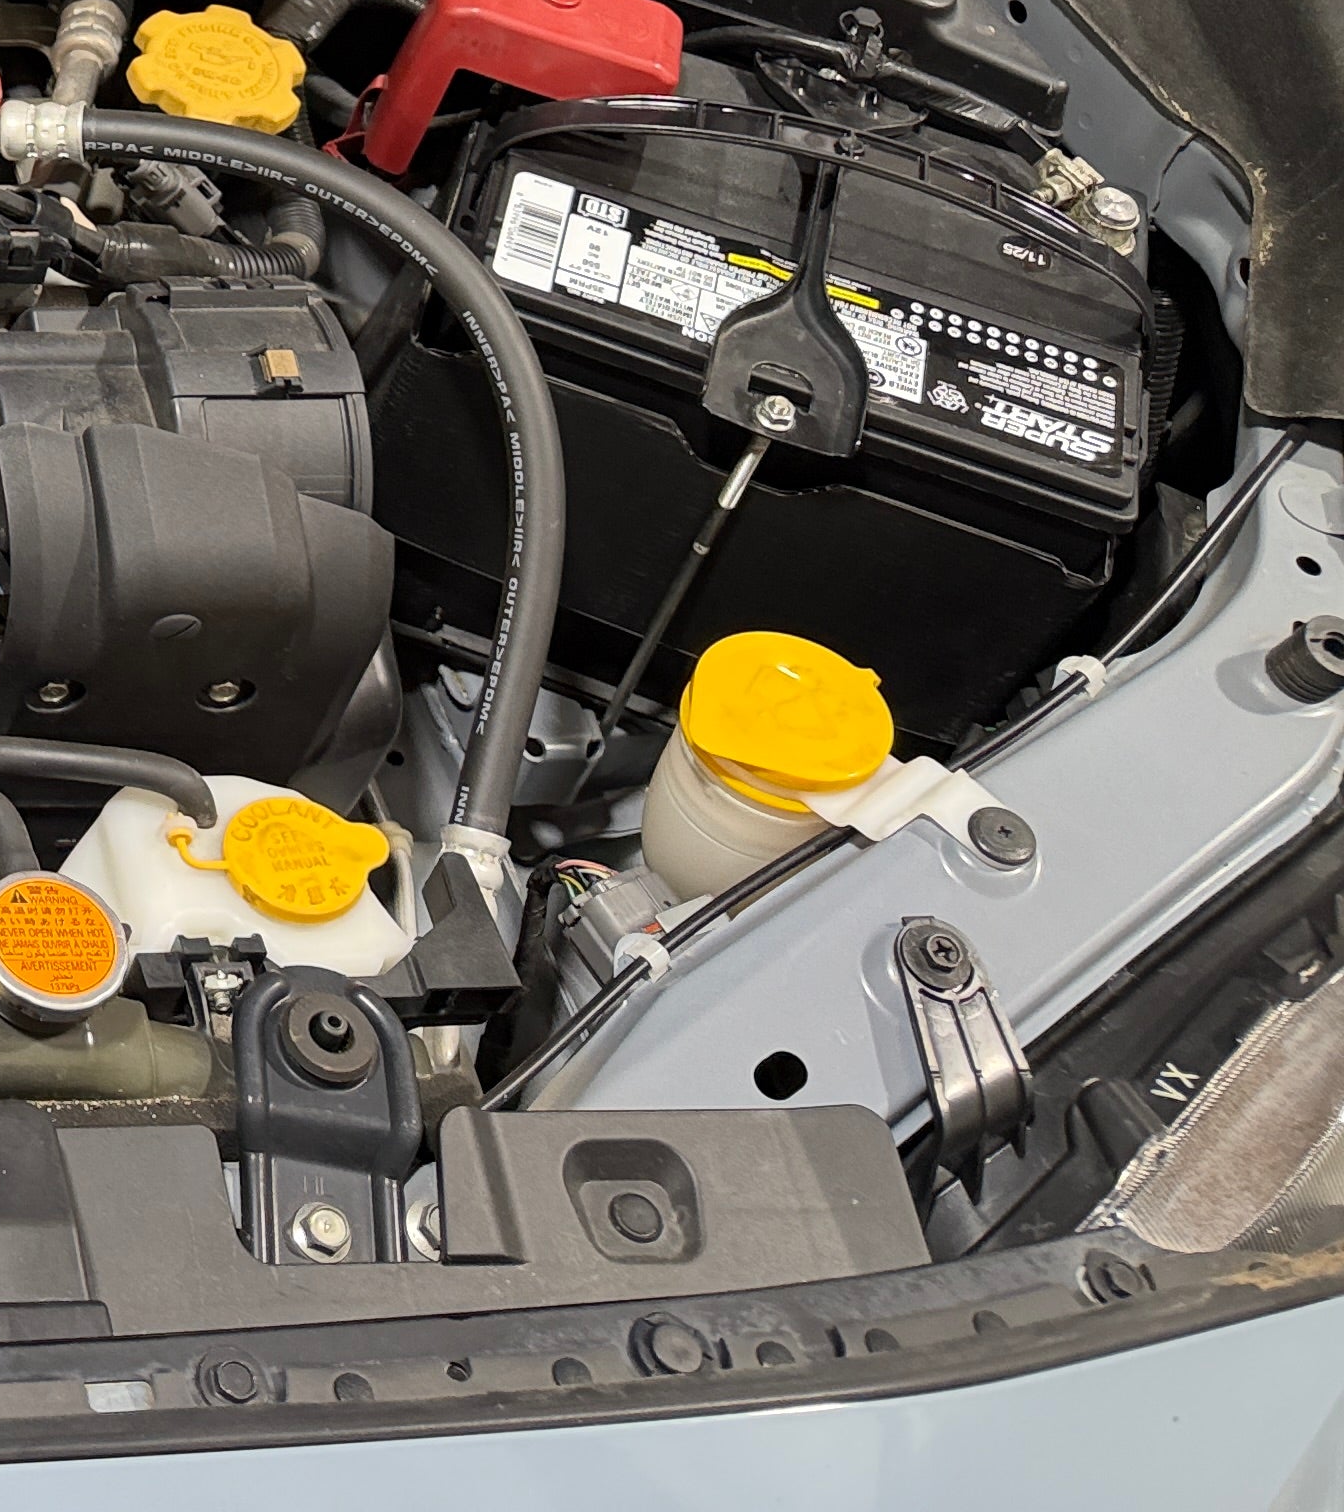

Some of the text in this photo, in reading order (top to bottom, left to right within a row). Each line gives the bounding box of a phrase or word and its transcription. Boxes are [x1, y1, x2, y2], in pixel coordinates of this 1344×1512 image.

[583, 197, 624, 222] STD
[585, 223, 609, 236] 12V
[1000, 242, 1048, 265] 11/25
[990, 399, 1115, 455] START
[979, 410, 1097, 462] SUPER
[231, 801, 341, 842] COOLANT
[271, 855, 332, 872] MANUAL
[28, 895, 79, 905] WARNING
[28, 928, 54, 938] OPEN
[56, 927, 84, 938] WHEN
[12, 940, 40, 950] JAMAIS
[42, 940, 72, 950] OUVRIR
[20, 961, 98, 972] AVERTISSEMENT
